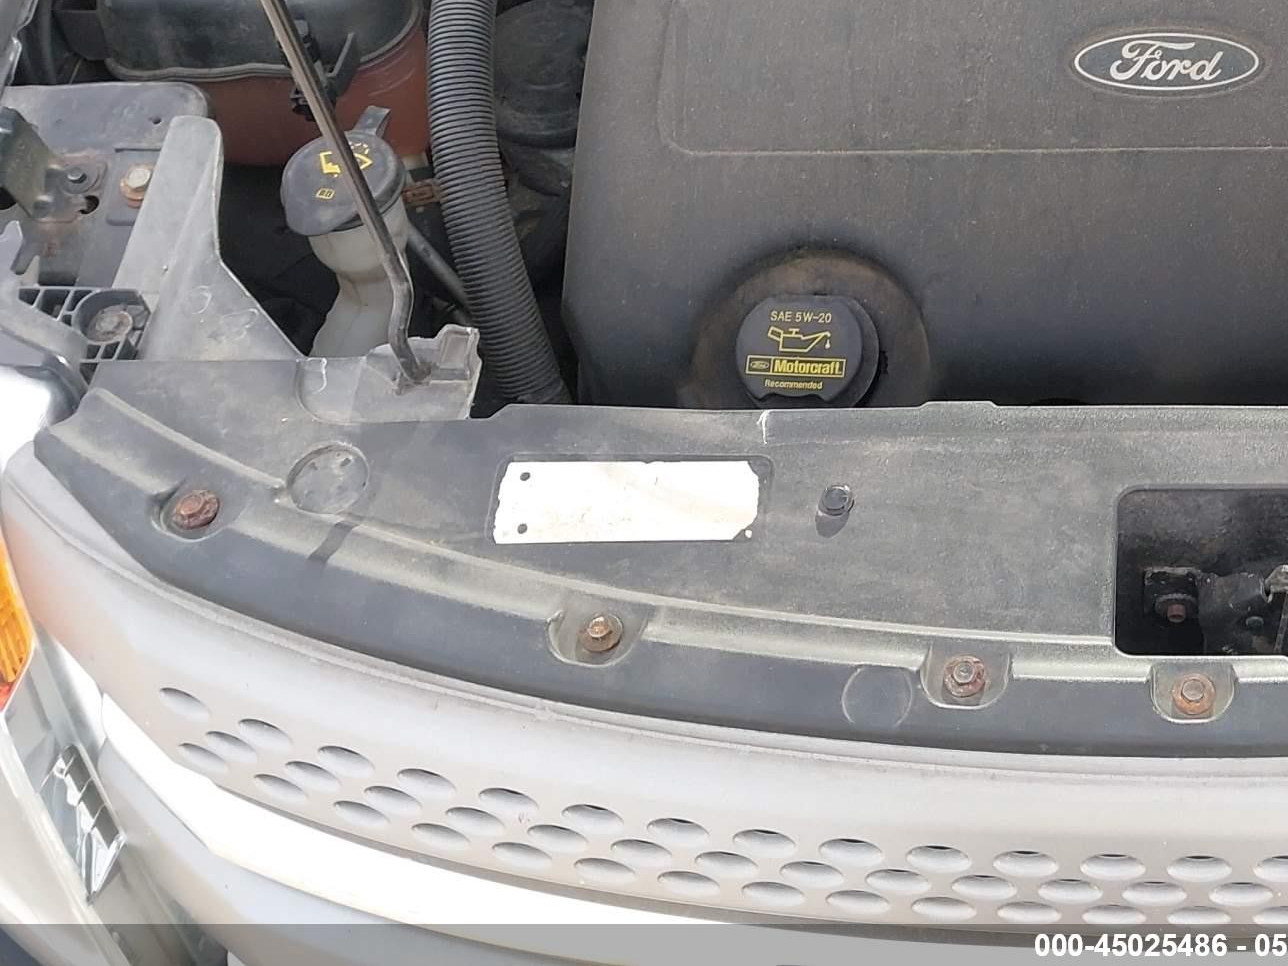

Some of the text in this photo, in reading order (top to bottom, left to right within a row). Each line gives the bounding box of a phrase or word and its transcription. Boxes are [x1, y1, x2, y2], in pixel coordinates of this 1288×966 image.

[1110, 40, 1223, 81] Ford
[770, 311, 832, 323] SAE 5W-20
[774, 359, 840, 375] Motorcraft
[764, 379, 823, 390] Recommended
